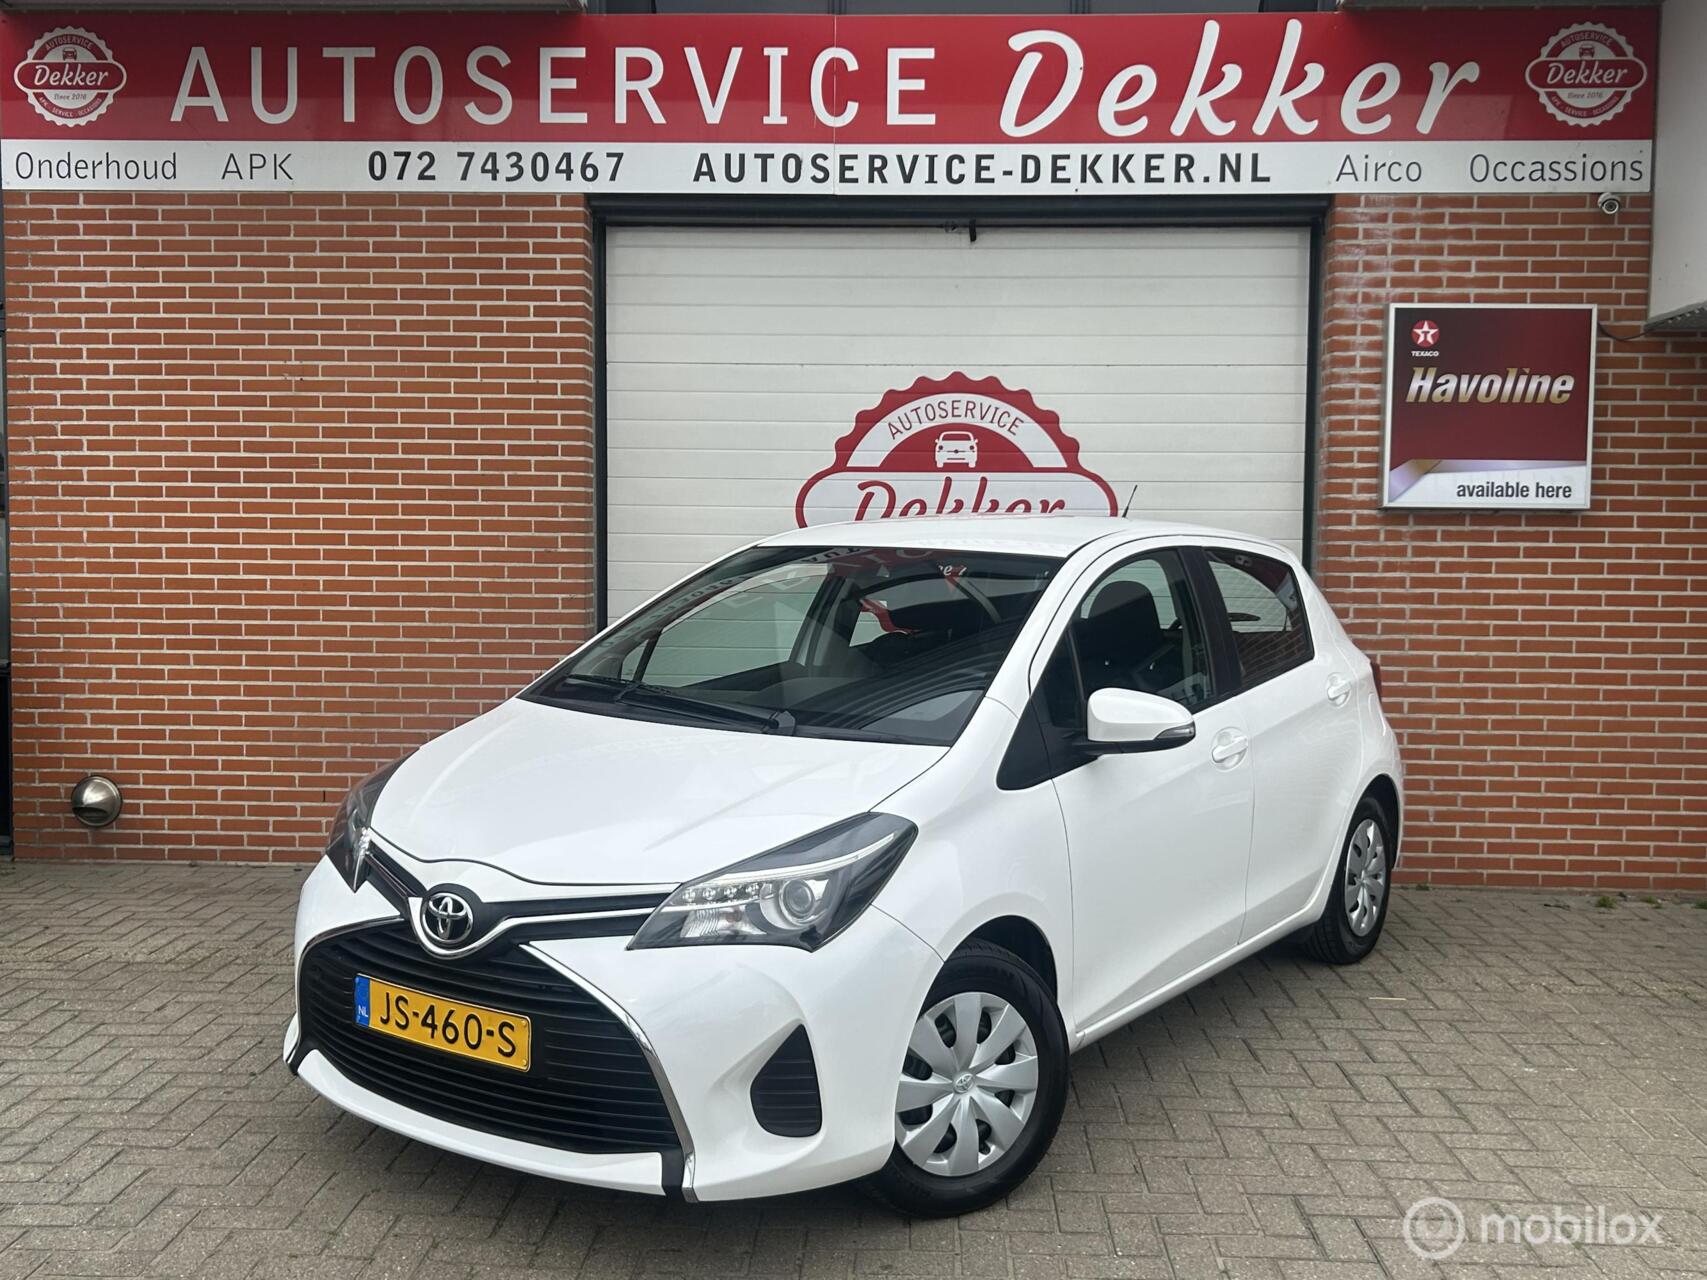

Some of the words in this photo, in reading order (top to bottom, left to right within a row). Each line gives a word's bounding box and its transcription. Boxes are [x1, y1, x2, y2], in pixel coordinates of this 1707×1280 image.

[45, 36, 93, 50] AUTOSERVICE
[1561, 32, 1613, 47] AUTOSERVICE
[34, 63, 109, 86] Dekker
[171, 46, 936, 128] AUTOSERVICE
[998, 18, 1480, 138] Dekker
[1546, 60, 1628, 85] Dekker
[15, 151, 177, 181] Onderhoud
[221, 152, 294, 181] APK
[368, 150, 436, 181] 072
[456, 151, 624, 183] 7430467
[693, 152, 1271, 185] AUTOSERVICE-DEKKER.NL
[1335, 154, 1423, 183] Airco
[1470, 153, 1643, 183] Occassions
[1411, 350, 1440, 358] TEXACO
[1406, 367, 1575, 404] Havoline
[887, 399, 1024, 441] AUTOSERVICE
[1456, 481, 1530, 498] available
[1535, 482, 1572, 499] here
[358, 1006, 369, 1018] NL
[380, 992, 517, 1059] JS-460-S
